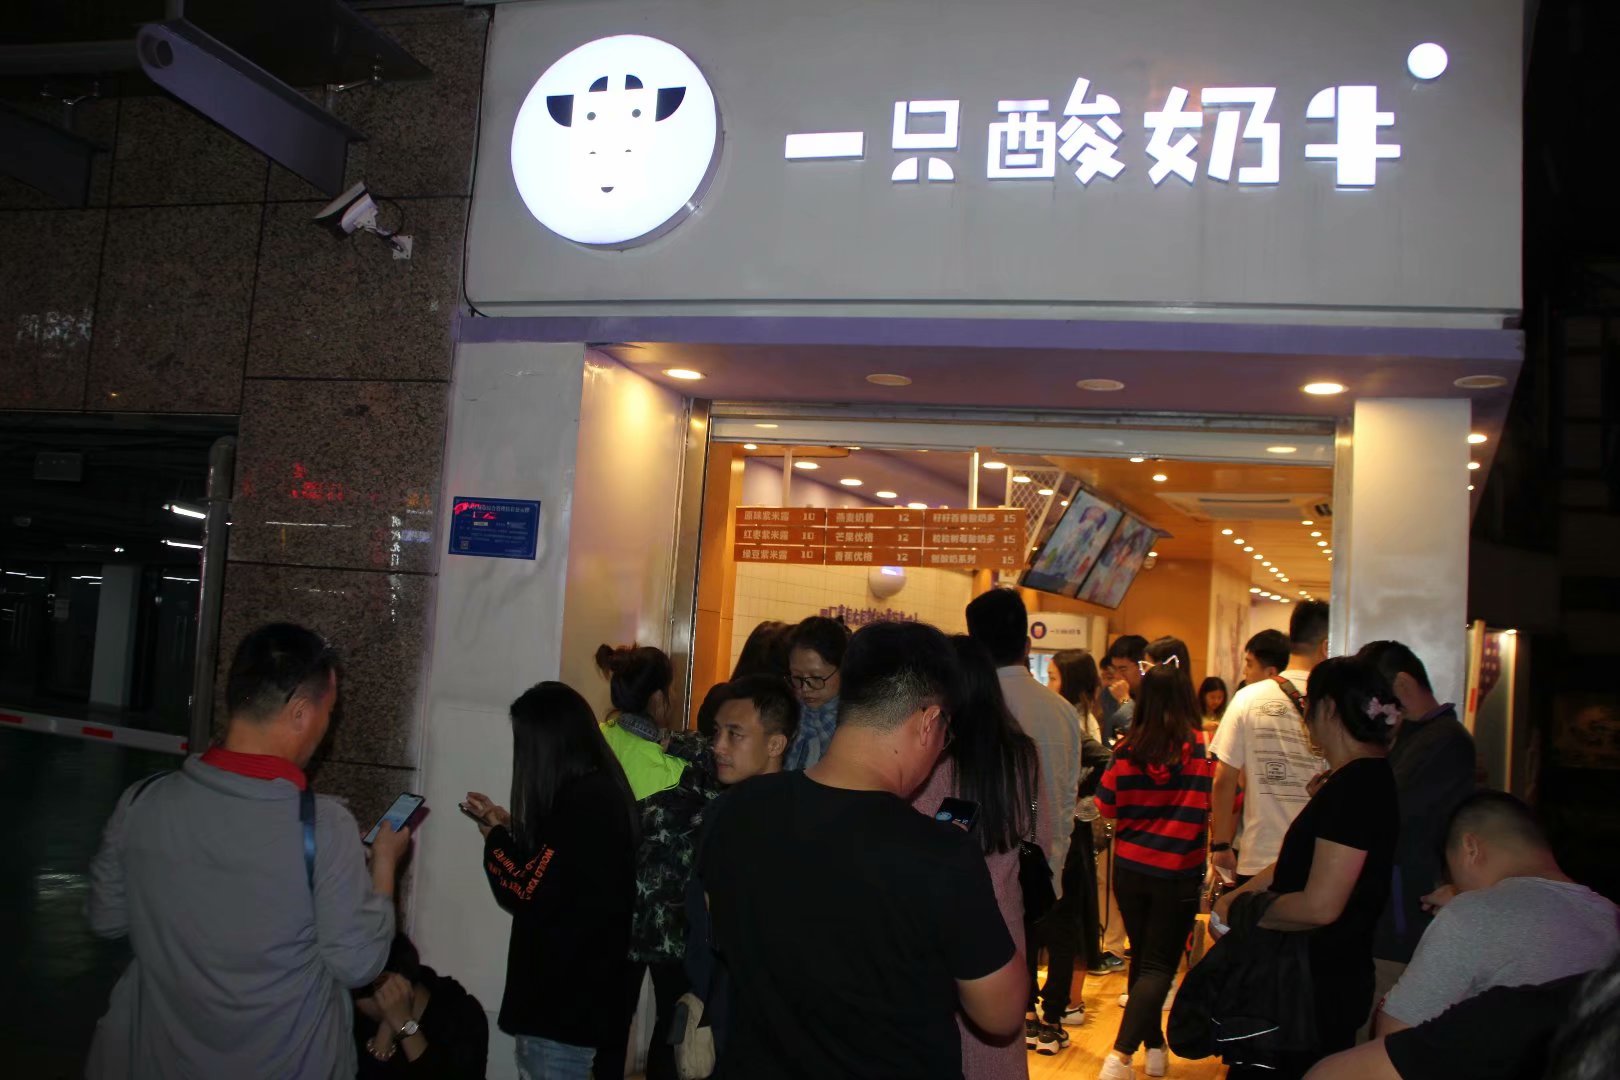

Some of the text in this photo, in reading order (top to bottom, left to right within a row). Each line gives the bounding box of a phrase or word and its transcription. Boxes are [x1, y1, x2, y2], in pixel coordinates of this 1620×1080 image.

[784, 77, 1402, 188] 一只酸奶牛
[803, 512, 816, 521] 10
[898, 513, 910, 522] 12
[1003, 514, 1016, 523] 15
[802, 532, 815, 540] 10
[835, 531, 909, 543] 芒果优格 12
[1003, 535, 1016, 544] 15
[801, 550, 814, 559] 10
[834, 551, 908, 562] 香蕉优格 12
[1002, 555, 1015, 565] 15
